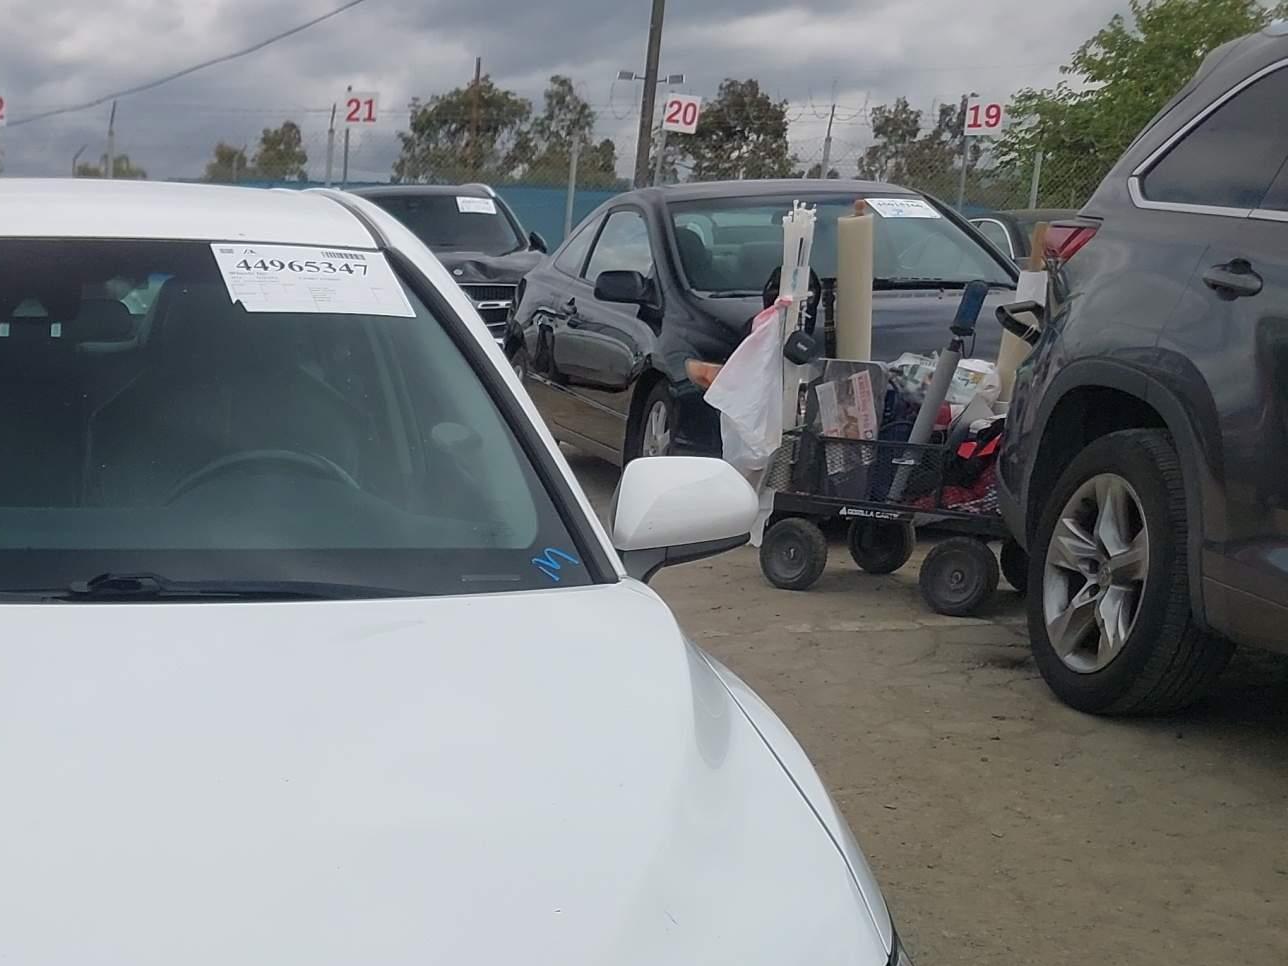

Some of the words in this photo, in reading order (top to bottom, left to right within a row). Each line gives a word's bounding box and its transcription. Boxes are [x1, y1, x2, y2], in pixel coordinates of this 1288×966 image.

[345, 98, 376, 122] 21
[665, 100, 697, 126] 20
[967, 103, 1001, 128] 19
[235, 259, 368, 275] 44965347
